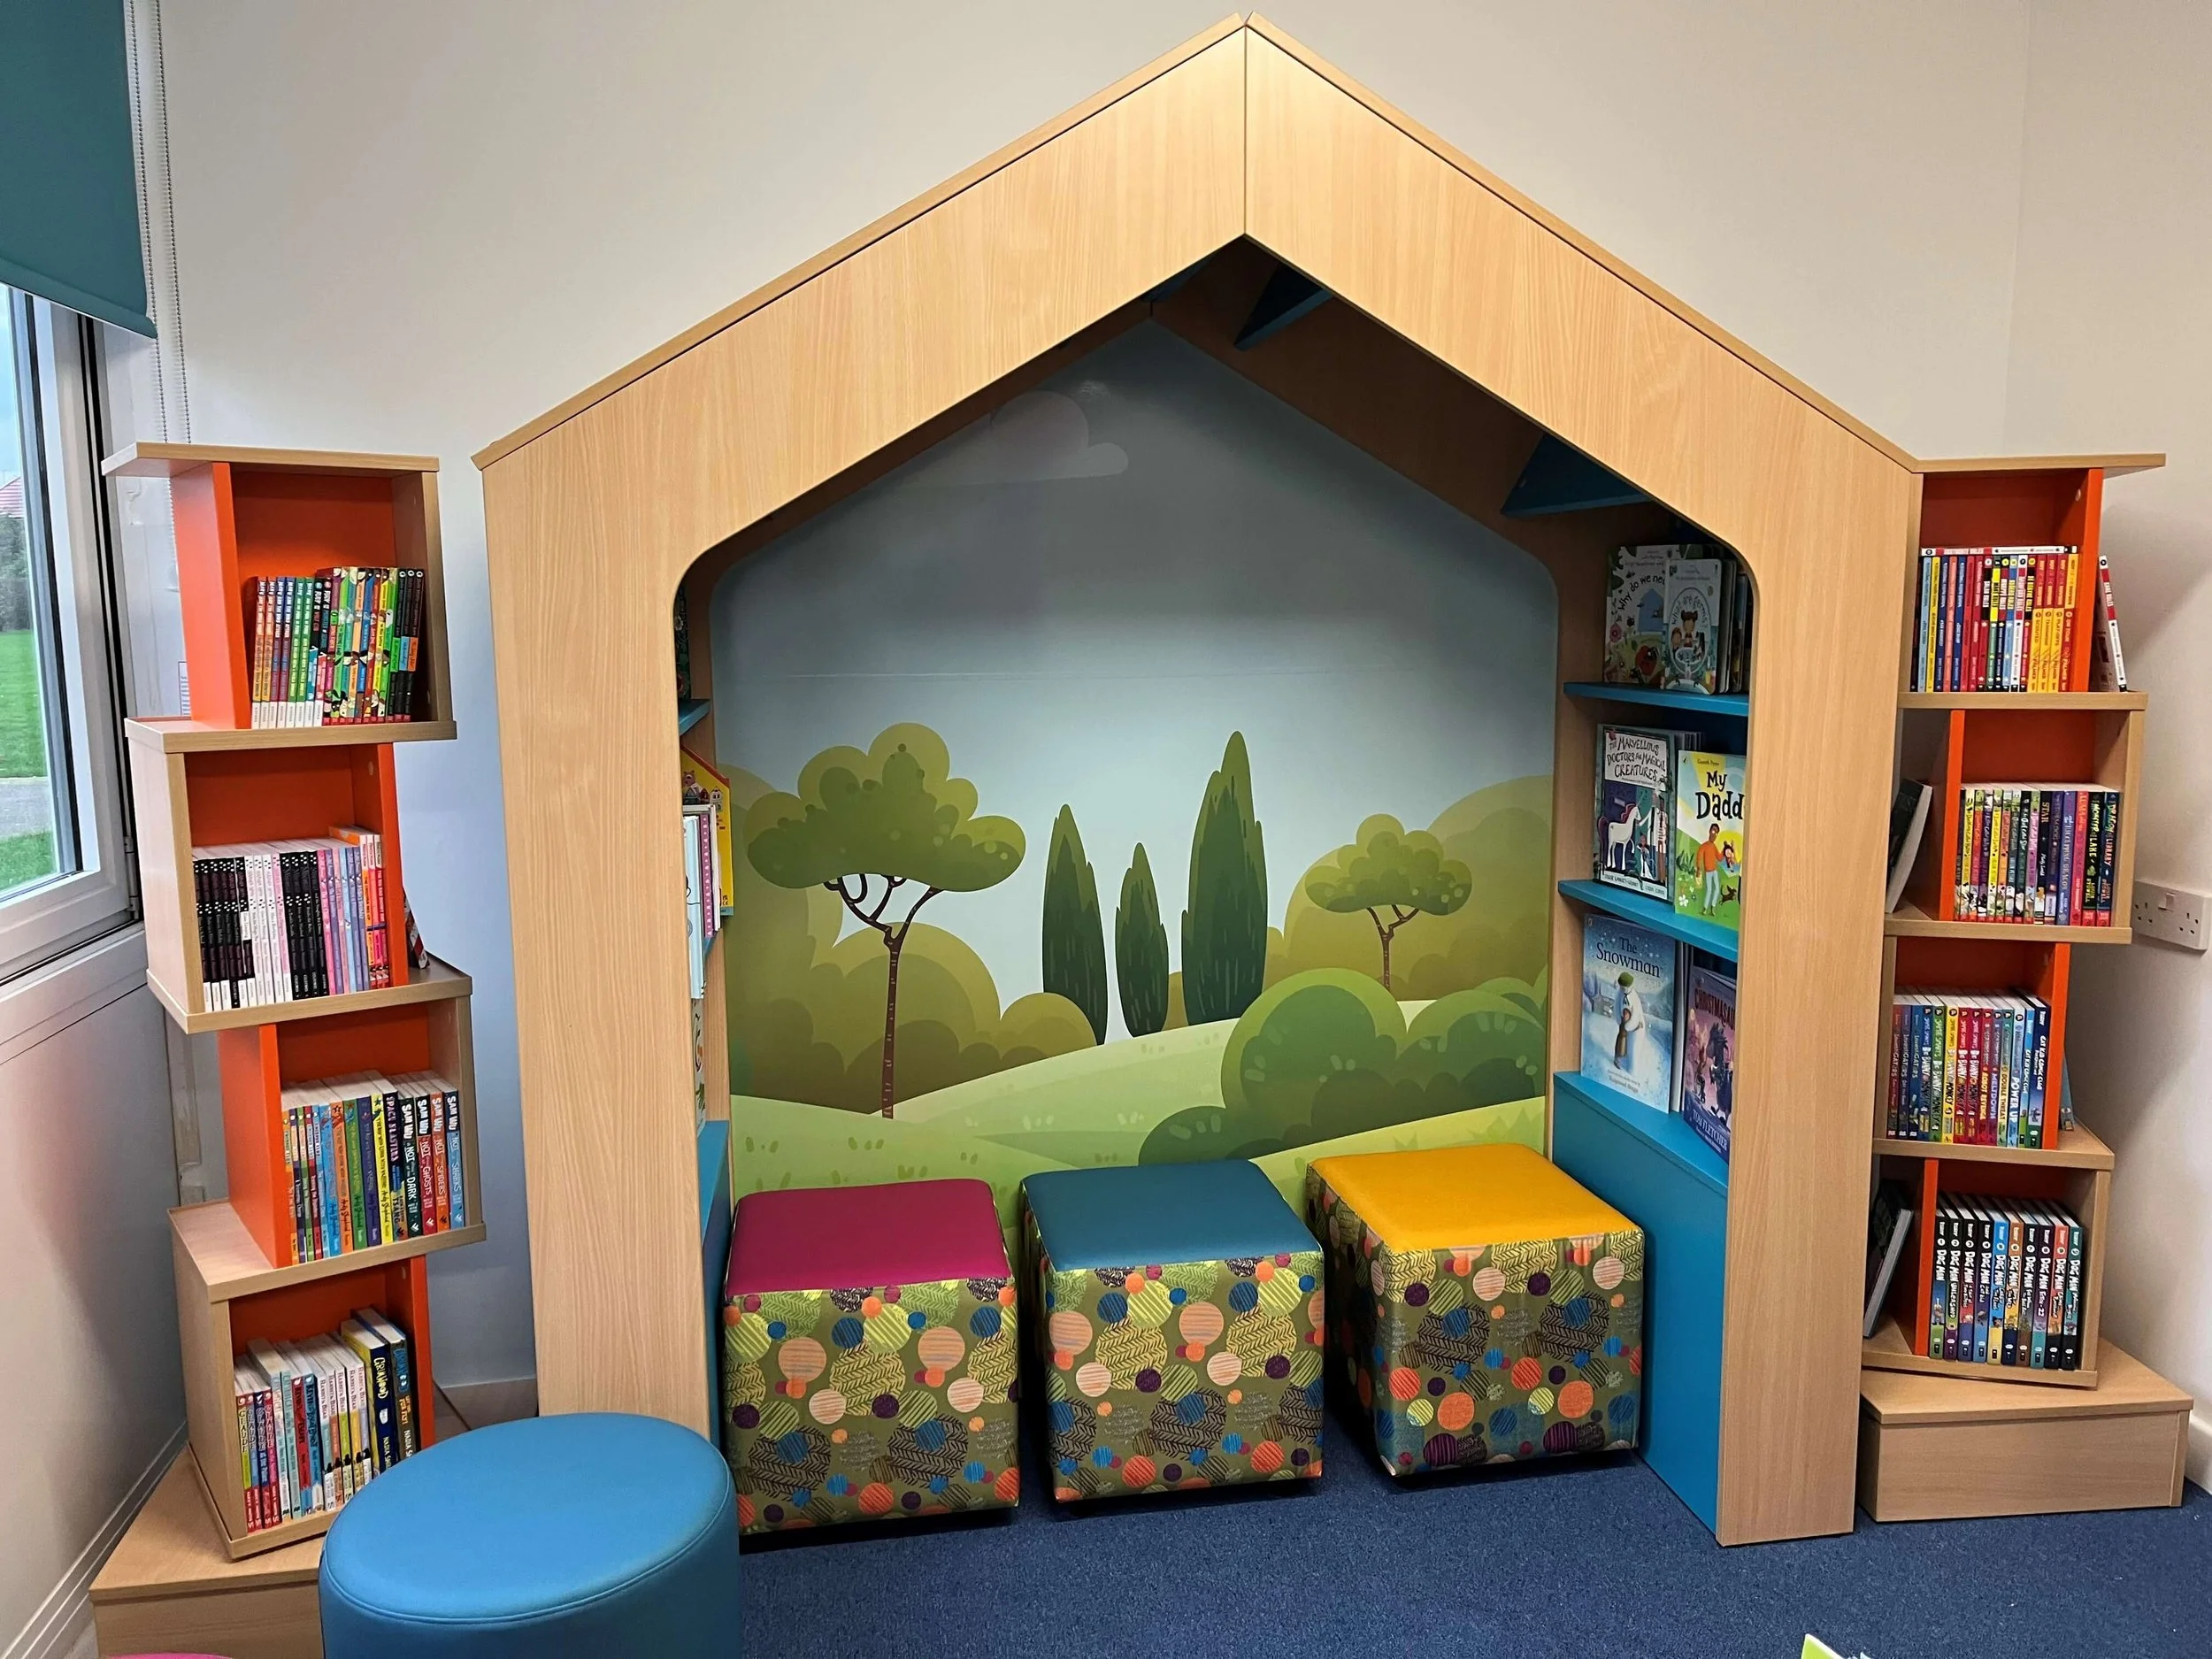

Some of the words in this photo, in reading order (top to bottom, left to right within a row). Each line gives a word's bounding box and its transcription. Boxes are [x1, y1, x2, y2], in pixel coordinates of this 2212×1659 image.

[1617, 593, 1632, 610] Why
[1631, 582, 1639, 592] do
[1640, 575, 1650, 584] we
[1617, 737, 1659, 756] MARVELLOUS
[1607, 751, 1634, 767] DOCTORS
[1641, 753, 1665, 772] MAGICAL
[1615, 764, 1657, 781] CREATURES
[1707, 771, 1727, 791] My
[1695, 792, 1745, 820] Dadd
[2104, 838, 2114, 866] LIBRARY
[1619, 938, 1637, 954] The
[1596, 942, 1660, 978] Snowman
[1694, 987, 1735, 1030] CHRISTMASAU
[1921, 1056, 1932, 1076] BUNNY
[1957, 1059, 1967, 1079] BUNNY
[1969, 1059, 1979, 1079] BUNNY
[1932, 1071, 1942, 1091] BUNNY
[1945, 1082, 1954, 1104] MONKEY
[2009, 1077, 2020, 1107] POWER
[386, 1096, 396, 1121] SPACE
[418, 1100, 428, 1118] SAM
[432, 1098, 442, 1116] SAM
[447, 1096, 457, 1114] SAM
[402, 1104, 413, 1123] SAM
[2009, 1110, 2018, 1123] UP
[419, 1120, 429, 1133] WU
[434, 1118, 443, 1132] WU
[448, 1116, 457, 1130] WU
[404, 1125, 414, 1139] WU
[388, 1124, 399, 1162] BLASTERS
[420, 1141, 431, 1157] NOT
[435, 1140, 444, 1155] NOT
[449, 1137, 459, 1151] NOT
[405, 1146, 415, 1162] NOT
[422, 1166, 432, 1195] GHOSTS
[436, 1166, 446, 1195] SPIDERS
[452, 1163, 461, 1192] SHARKS
[407, 1176, 416, 1200] DARK
[1936, 1249, 1947, 1264] DOG
[1949, 1250, 1961, 1265] DOG
[1964, 1251, 1975, 1266] DOG
[1980, 1252, 1992, 1268] DOG
[1995, 1255, 2006, 1271] DOG
[2009, 1256, 2020, 1271] DOG
[2024, 1256, 2036, 1272] DOG
[1936, 1265, 1947, 1280] MAN
[2039, 1257, 2051, 1273] DOG
[2055, 1258, 2066, 1274] DOG
[2070, 1260, 2080, 1275] DOG
[1949, 1267, 1960, 1282] MAN
[1964, 1268, 1974, 1283] MAN
[1980, 1269, 1991, 1283] MAN
[1994, 1271, 2005, 1286] MAN
[2008, 1271, 2019, 1286] MAN
[2024, 1272, 2035, 1288] MAN
[2039, 1274, 2049, 1289] MAN
[2055, 1274, 2065, 1289] MAN
[2069, 1277, 2079, 1292] MAN
[373, 1357, 388, 1399] GRIMWOOD
[238, 1407, 248, 1453] CLAUDE
